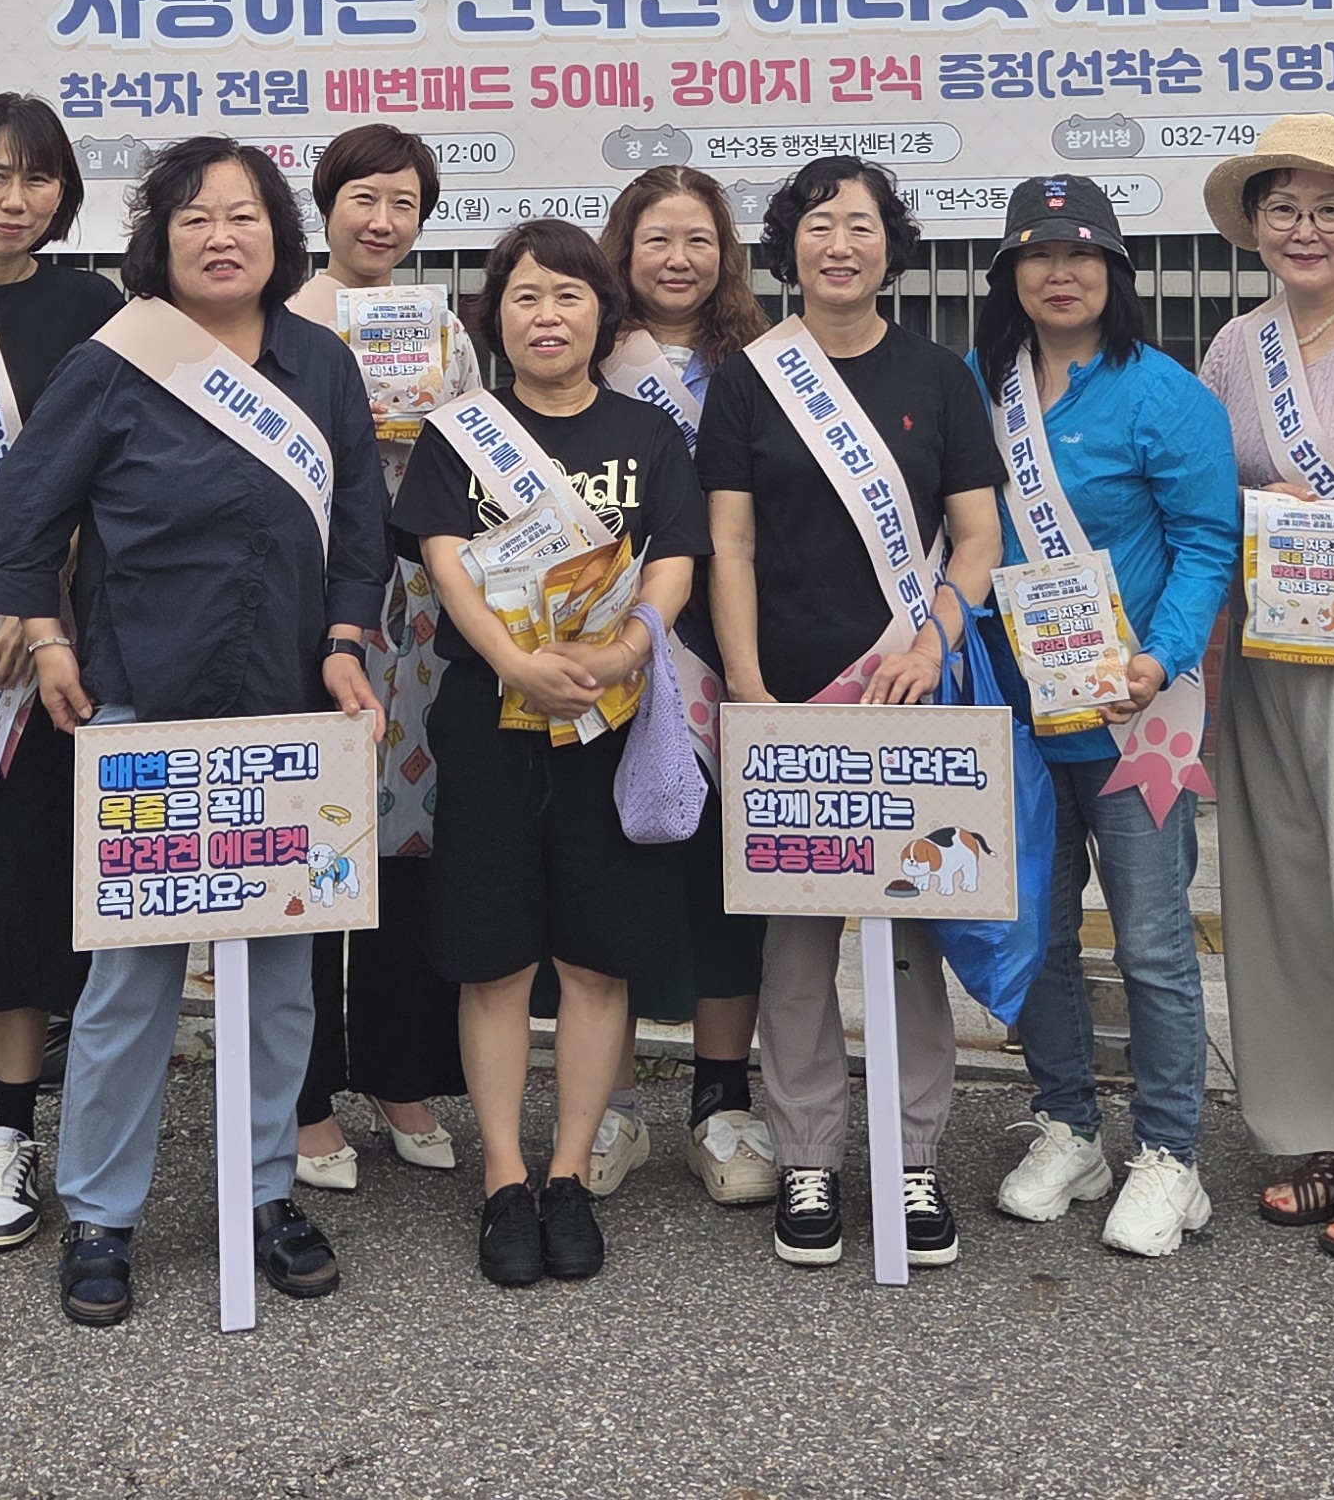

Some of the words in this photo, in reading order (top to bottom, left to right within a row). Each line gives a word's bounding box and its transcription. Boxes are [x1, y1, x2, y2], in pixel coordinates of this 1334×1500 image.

[58, 68, 202, 119] 참석자
[215, 67, 310, 117] 전원
[324, 65, 515, 115] 배변패드
[530, 60, 655, 112] 50매,
[670, 56, 811, 106] 강아지
[828, 54, 923, 102] 간식
[938, 44, 1203, 102] 증정(선착순
[707, 137, 779, 159] 연수3동
[781, 132, 895, 156] 행정복지센터
[900, 132, 934, 154] 2층
[1065, 130, 1131, 149] 참가신청
[1161, 125, 1261, 146] 032-749-
[1259, 320, 1291, 389] 모두를
[204, 368, 288, 441] 모두를
[287, 433, 329, 491] 위한
[1272, 388, 1303, 440] 위한
[455, 405, 524, 473] 모두를
[513, 470, 546, 504] 위
[776, 347, 838, 420] 모두를
[824, 421, 874, 476] 위한
[862, 478, 910, 568] 반려견
[898, 570, 928, 632] 에티
[1011, 437, 1043, 496] 위한
[1028, 501, 1072, 561] 반려
[1269, 536, 1304, 550] 배변은
[1271, 565, 1306, 580] 반려견
[1279, 580, 1291, 594] 꼭
[1024, 609, 1059, 625] 배변은
[1061, 602, 1099, 619] 치우고!
[1032, 637, 1067, 655] 반려견
[1068, 631, 1104, 648] 에티켓
[1042, 654, 1055, 667] 꼭
[1056, 648, 1098, 665] 지켜요~
[1269, 651, 1299, 662] SWEET
[99, 750, 201, 791] 배변은
[207, 742, 319, 785] 치우고!
[743, 744, 873, 784] 사랑하는
[878, 746, 987, 790] 반려견,
[99, 791, 200, 832] 목줄은
[208, 787, 264, 826] 꼭!!
[744, 789, 811, 829] 함께
[816, 790, 915, 830] 지키는
[99, 832, 201, 877] 반려견
[208, 825, 309, 869] 에티켓
[745, 833, 875, 875] 공공질서
[98, 880, 133, 919] 꼭
[139, 873, 266, 918] 지켜요~
